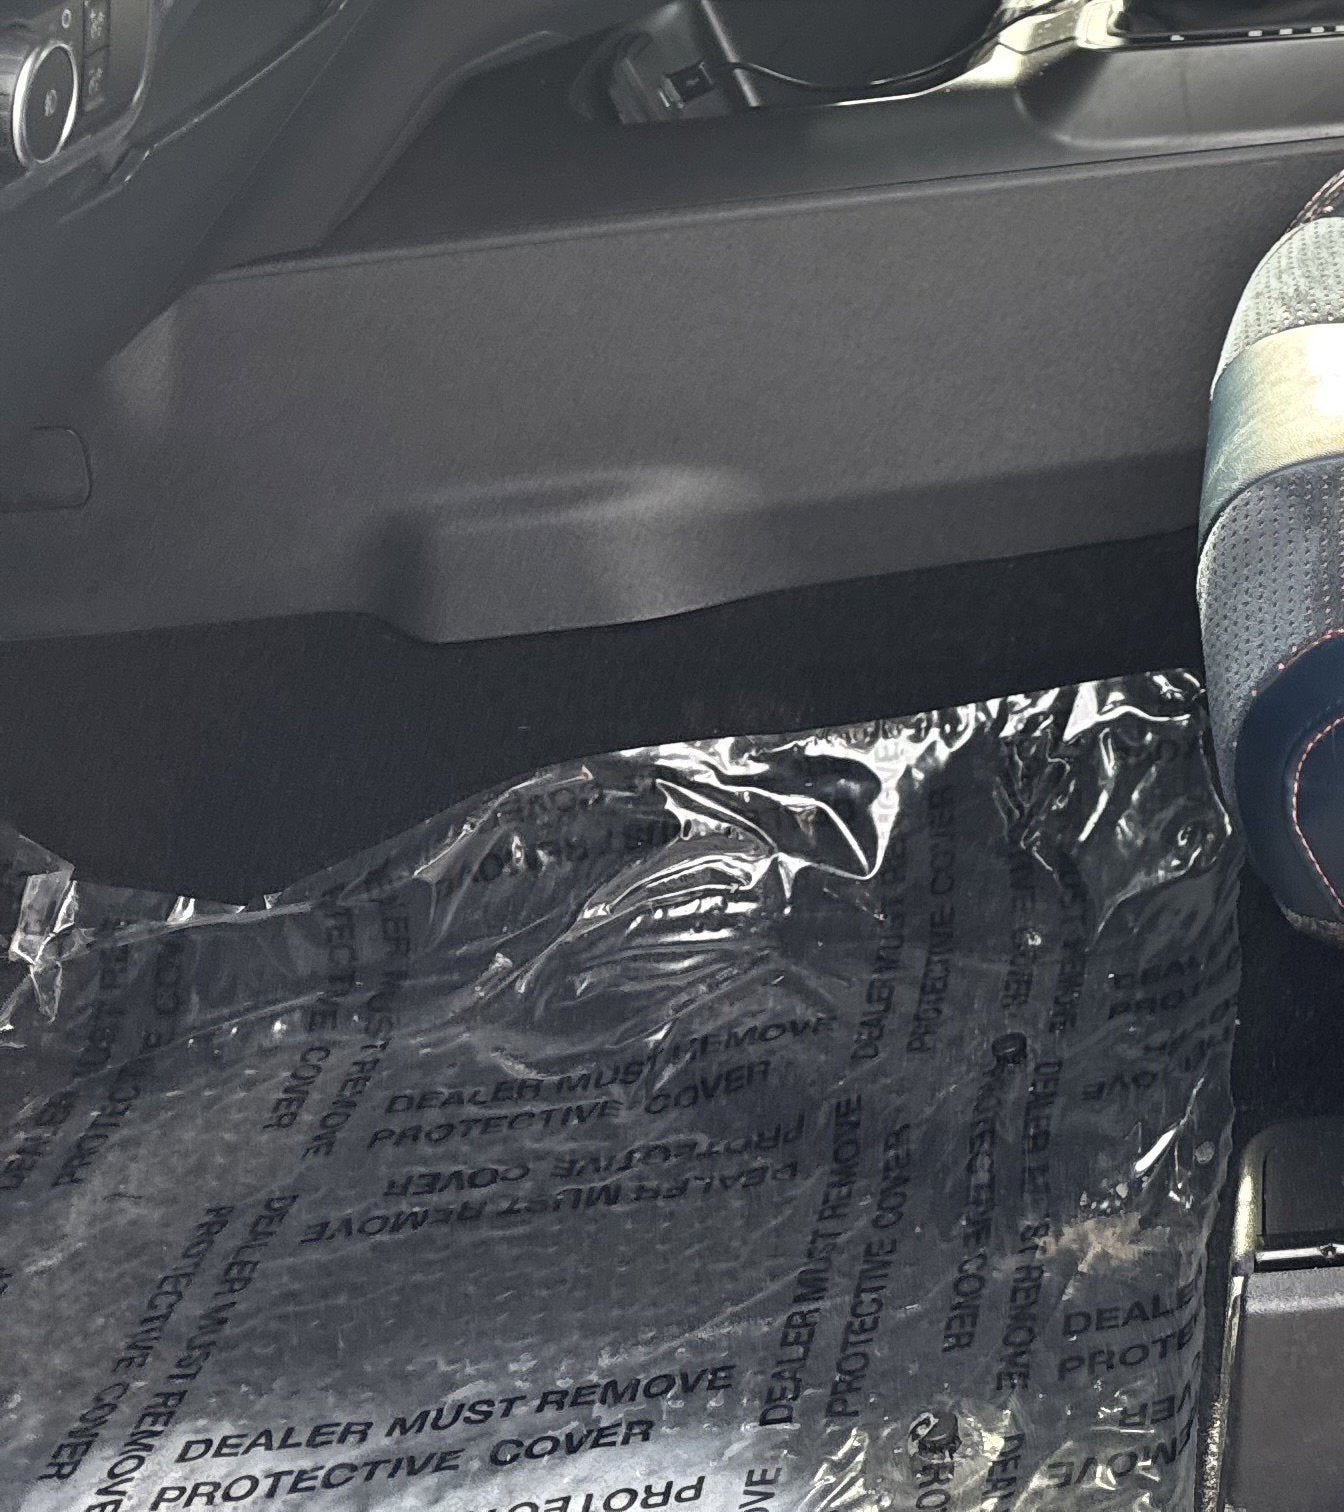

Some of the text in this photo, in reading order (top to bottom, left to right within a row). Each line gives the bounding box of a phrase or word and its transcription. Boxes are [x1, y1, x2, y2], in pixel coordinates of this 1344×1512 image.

[261, 1045, 332, 1131] COVER
[302, 1059, 381, 1163] REMOVE
[367, 1059, 772, 1149] PROTECTIVE COVER
[385, 1078, 545, 1115] DEALER
[383, 1112, 808, 1200] PROTECTIVE COVER
[215, 1194, 300, 1297] DEALER
[298, 1199, 487, 1244] REMOVE
[758, 1308, 822, 1427] DEALER
[817, 1094, 862, 1222] REMOVE
[825, 1123, 912, 1419] PROTECTIVE COVER
[111, 1204, 235, 1374] PROTECTIVE
[942, 1252, 988, 1354] COVER
[996, 1263, 1046, 1392] REMOVE
[1062, 1282, 1200, 1336] DEALE
[37, 1381, 131, 1481] COVER
[84, 1389, 190, 1512] REMOVE
[150, 1419, 658, 1511] PROTECTIVE COVER
[175, 1363, 738, 1465] DEALER MUST REMOVE
